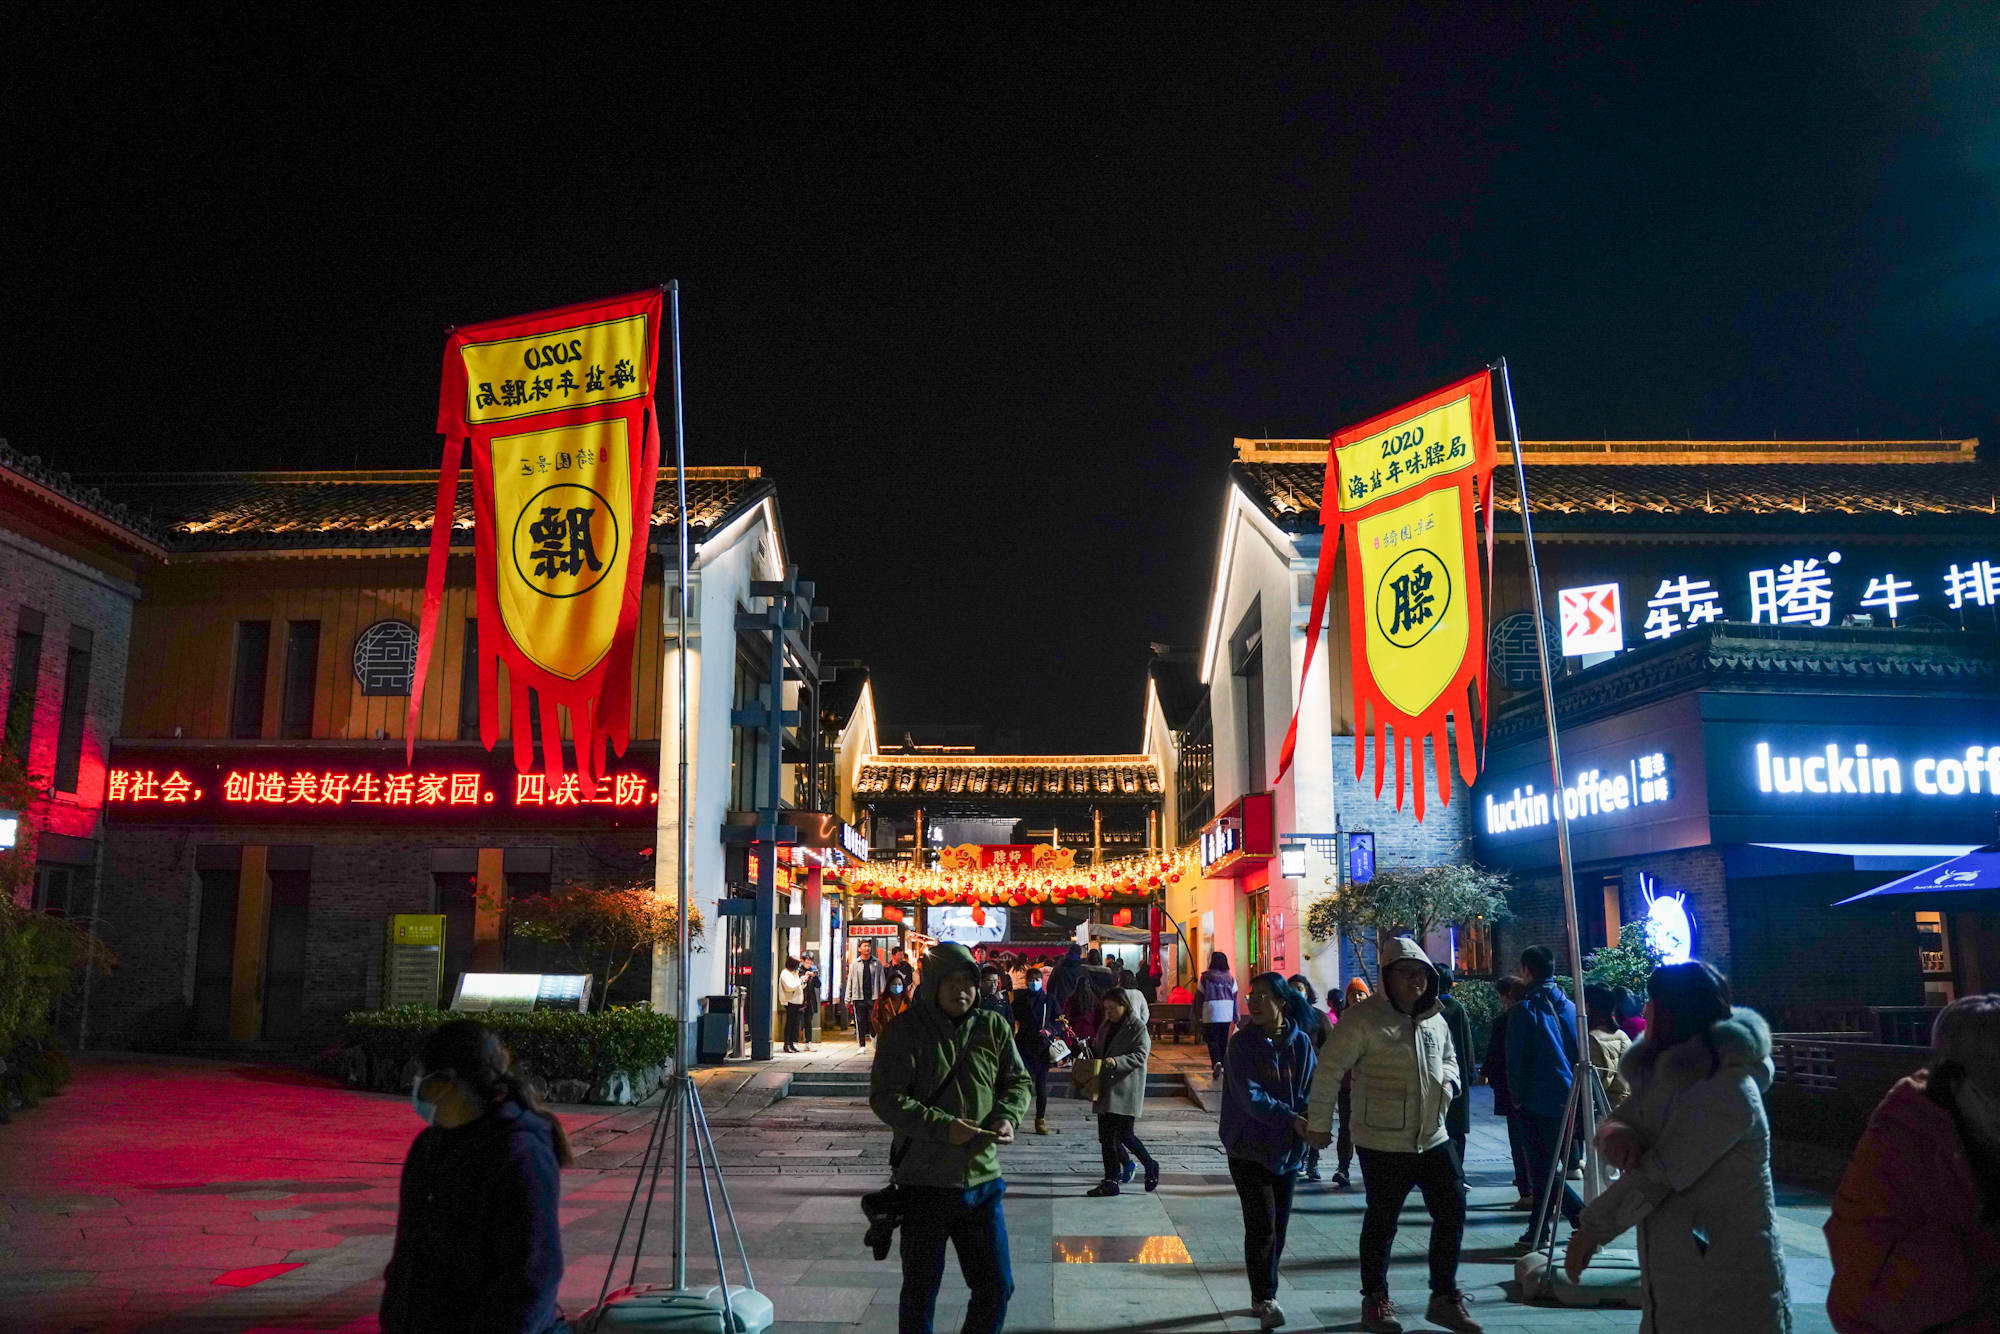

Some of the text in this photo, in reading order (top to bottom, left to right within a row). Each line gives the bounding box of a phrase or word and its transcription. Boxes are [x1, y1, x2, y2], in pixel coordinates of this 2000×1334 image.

[1381, 426, 1424, 459] 2020
[1757, 742, 2000, 795] luckin coff
[1486, 784, 1550, 835] luckin
